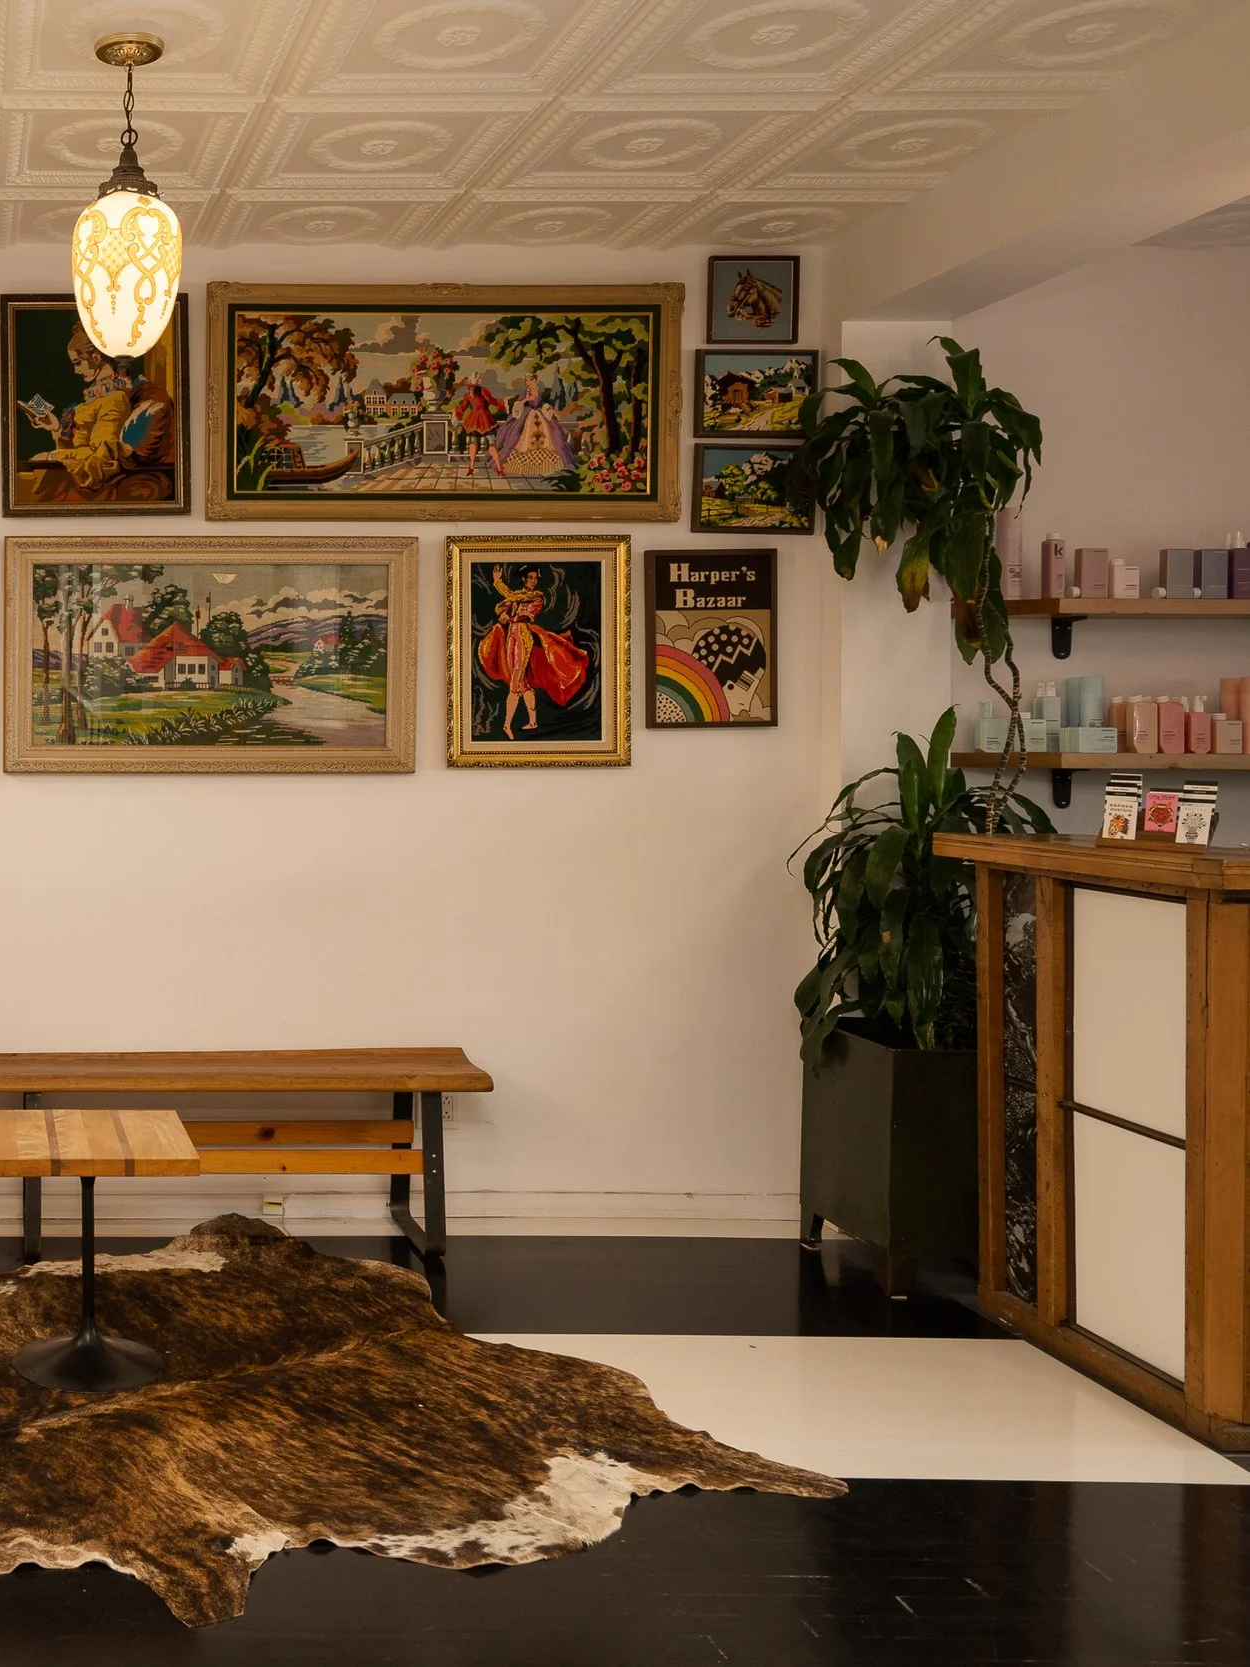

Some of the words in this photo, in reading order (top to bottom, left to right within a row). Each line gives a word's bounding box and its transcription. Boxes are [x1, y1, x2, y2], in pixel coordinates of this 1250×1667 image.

[1054, 543, 1063, 556] k
[669, 563, 756, 585] Harper's
[674, 588, 747, 609] Bazaar
